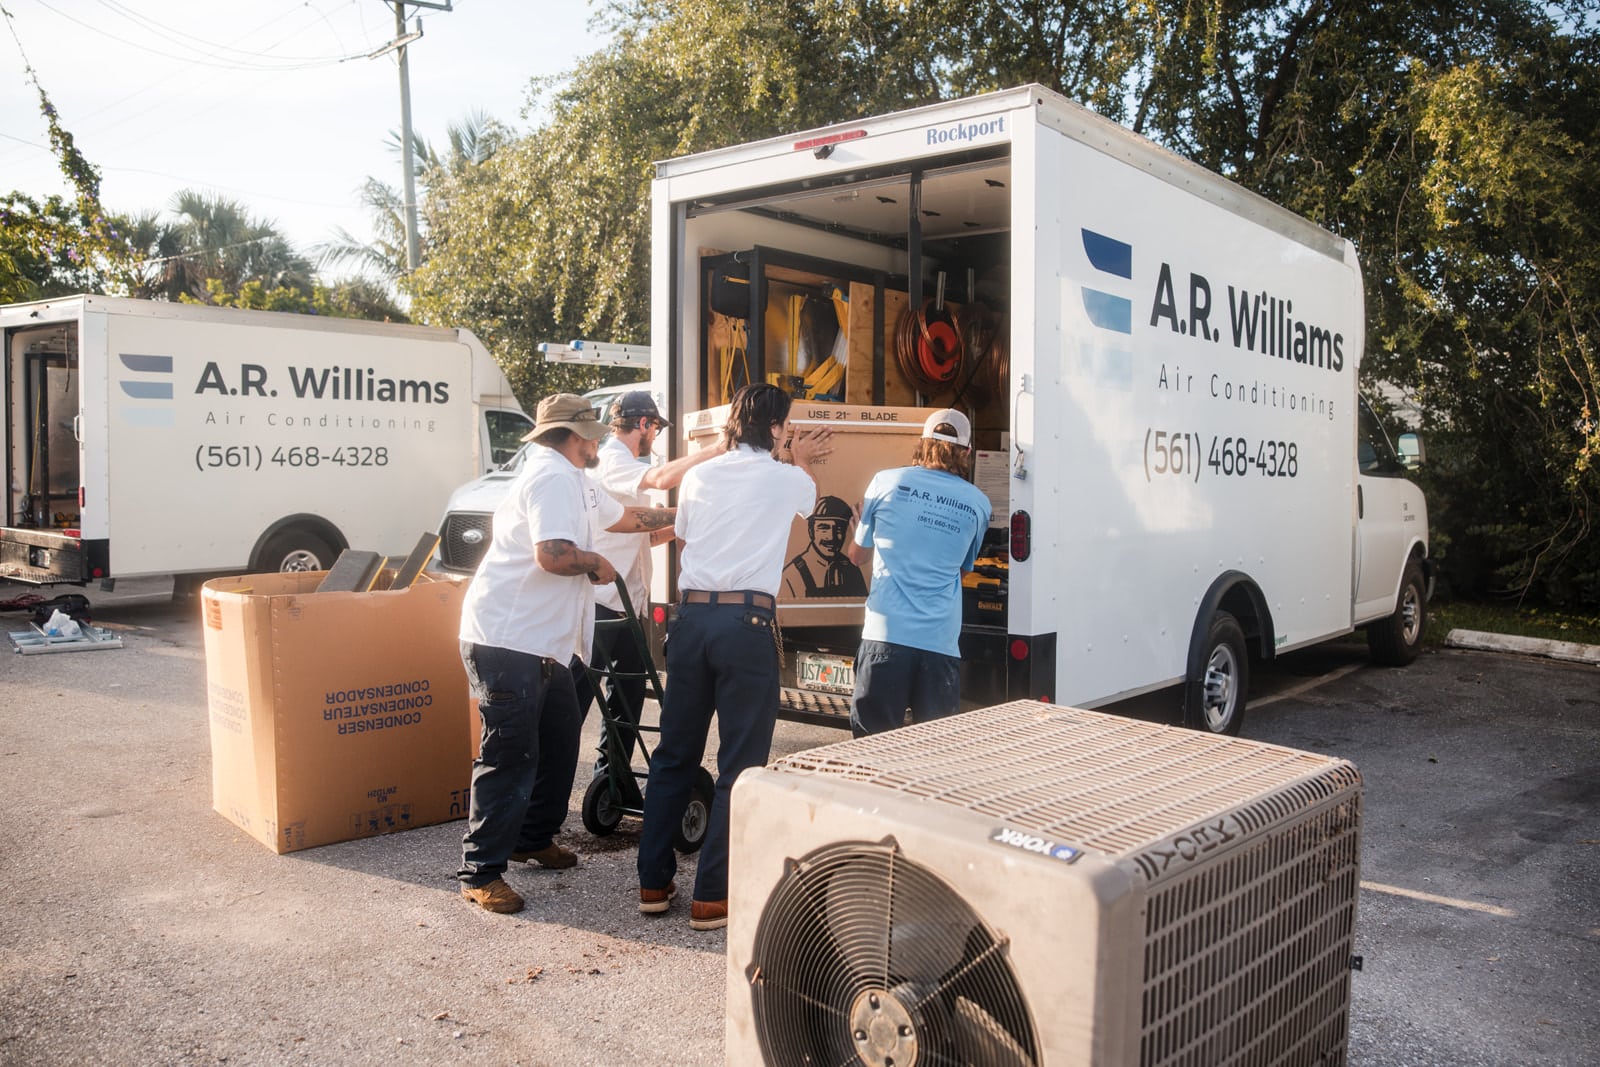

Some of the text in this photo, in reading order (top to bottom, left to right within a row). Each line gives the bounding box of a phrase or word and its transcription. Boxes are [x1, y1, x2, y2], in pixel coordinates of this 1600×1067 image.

[927, 117, 1004, 145] Rockport
[1150, 262, 1344, 372] A.R. Williams
[195, 361, 450, 405] A.R. Williams
[1158, 363, 1335, 420] Air Conditioning
[205, 411, 437, 433] Air Conditioning
[808, 410, 830, 419] USE
[860, 412, 898, 421] BLADE
[195, 445, 389, 472] (561) 468-4328
[1143, 428, 1299, 483] (561) 468-4328
[910, 489, 977, 516] A.R. Williams
[325, 679, 430, 705] CONDENSADOR
[323, 694, 433, 721] CONDENSATEUR
[337, 712, 421, 735] CONDENSER
[993, 828, 1055, 855] YORK
